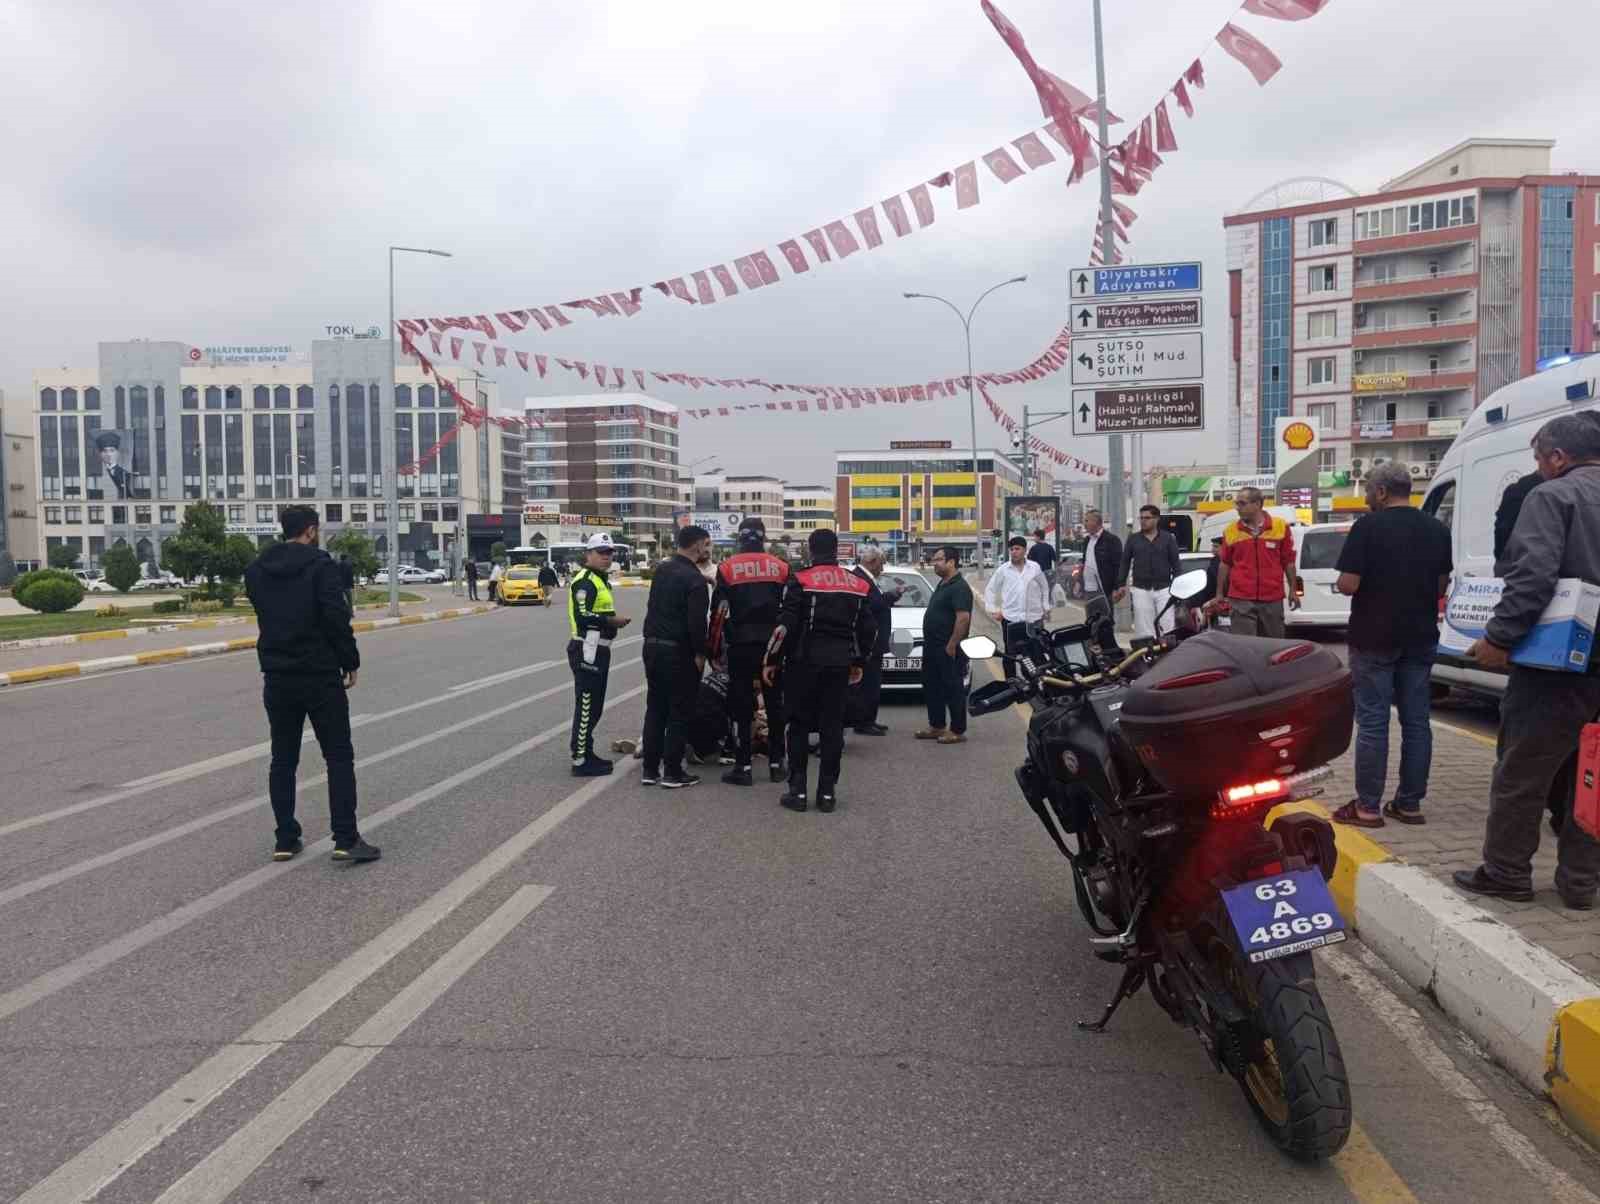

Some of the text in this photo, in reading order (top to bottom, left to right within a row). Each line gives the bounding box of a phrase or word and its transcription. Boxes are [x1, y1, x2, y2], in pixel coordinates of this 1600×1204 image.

[1097, 354, 1126, 364] SGK
[1255, 880, 1297, 900] 63
[1273, 901, 1298, 919] A
[1250, 913, 1333, 944] 4869
